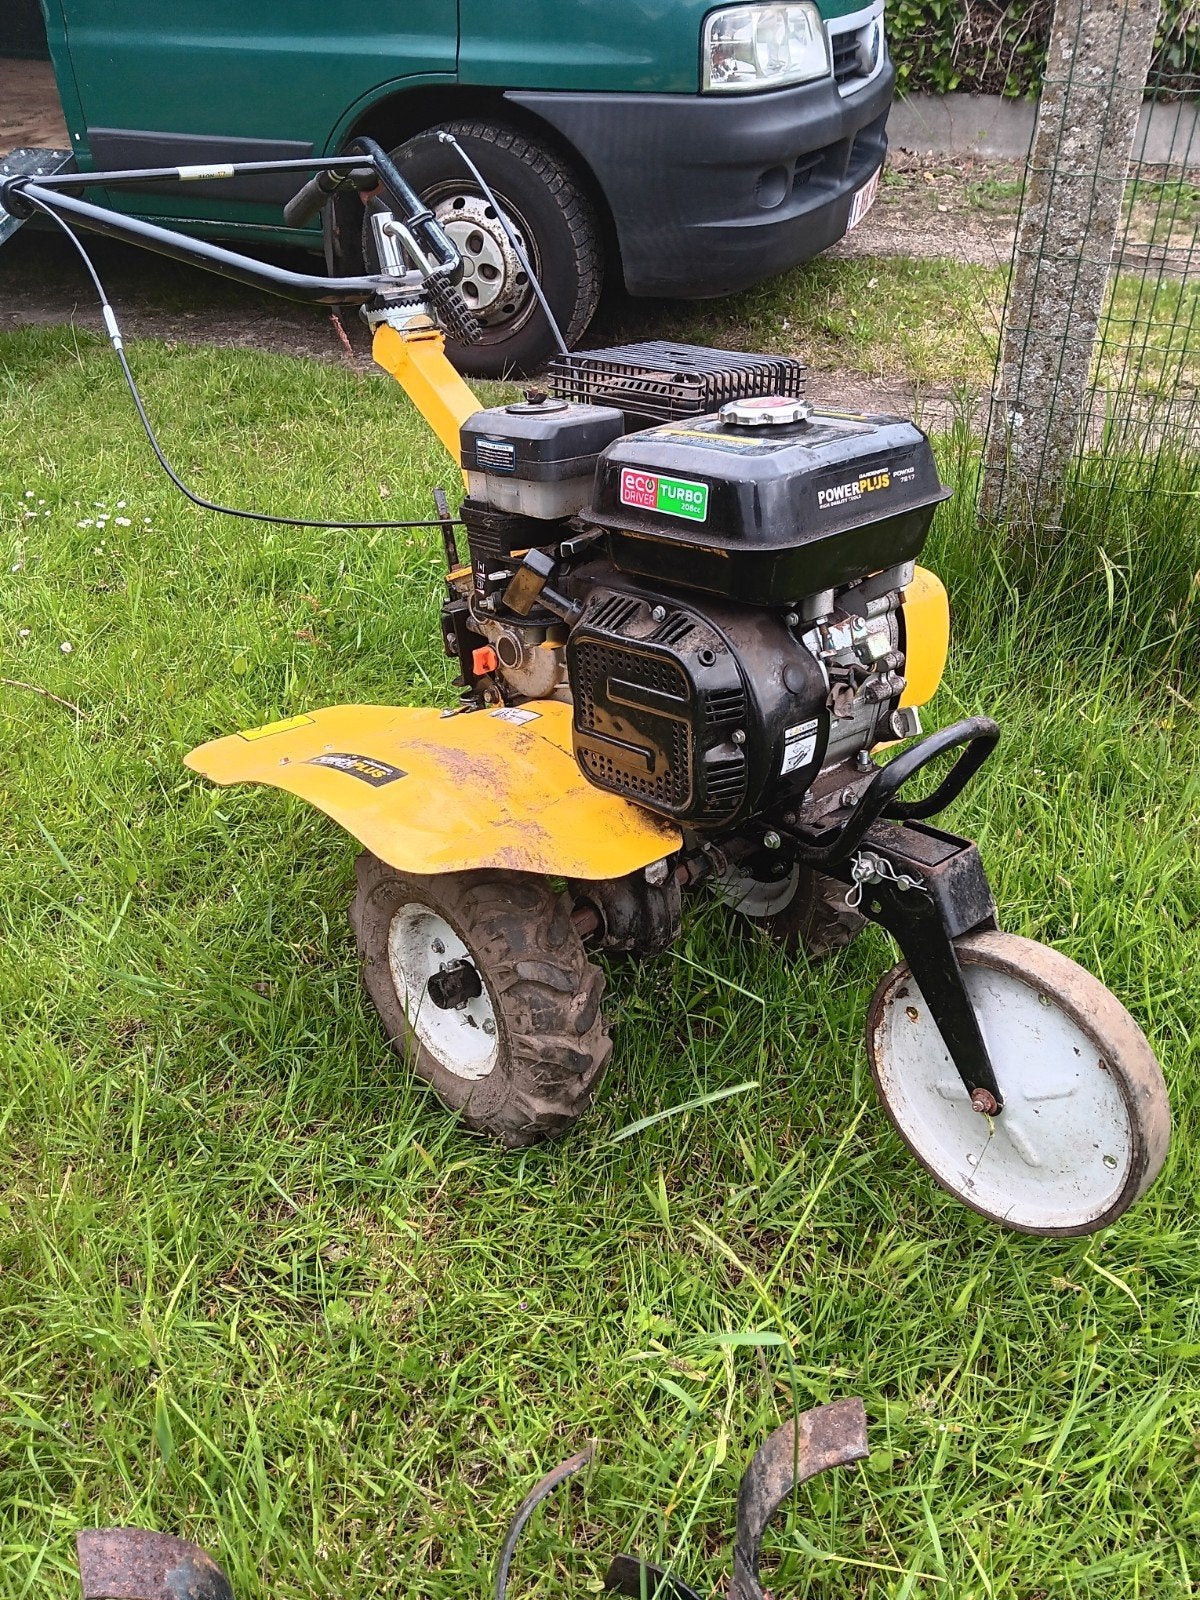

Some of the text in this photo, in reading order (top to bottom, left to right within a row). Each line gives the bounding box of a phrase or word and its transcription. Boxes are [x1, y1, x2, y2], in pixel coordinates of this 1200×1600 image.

[660, 484, 703, 504] TURBO
[818, 473, 890, 504] POWERPLUS
[624, 490, 654, 505] DRIVER
[681, 503, 701, 513] 208cc
